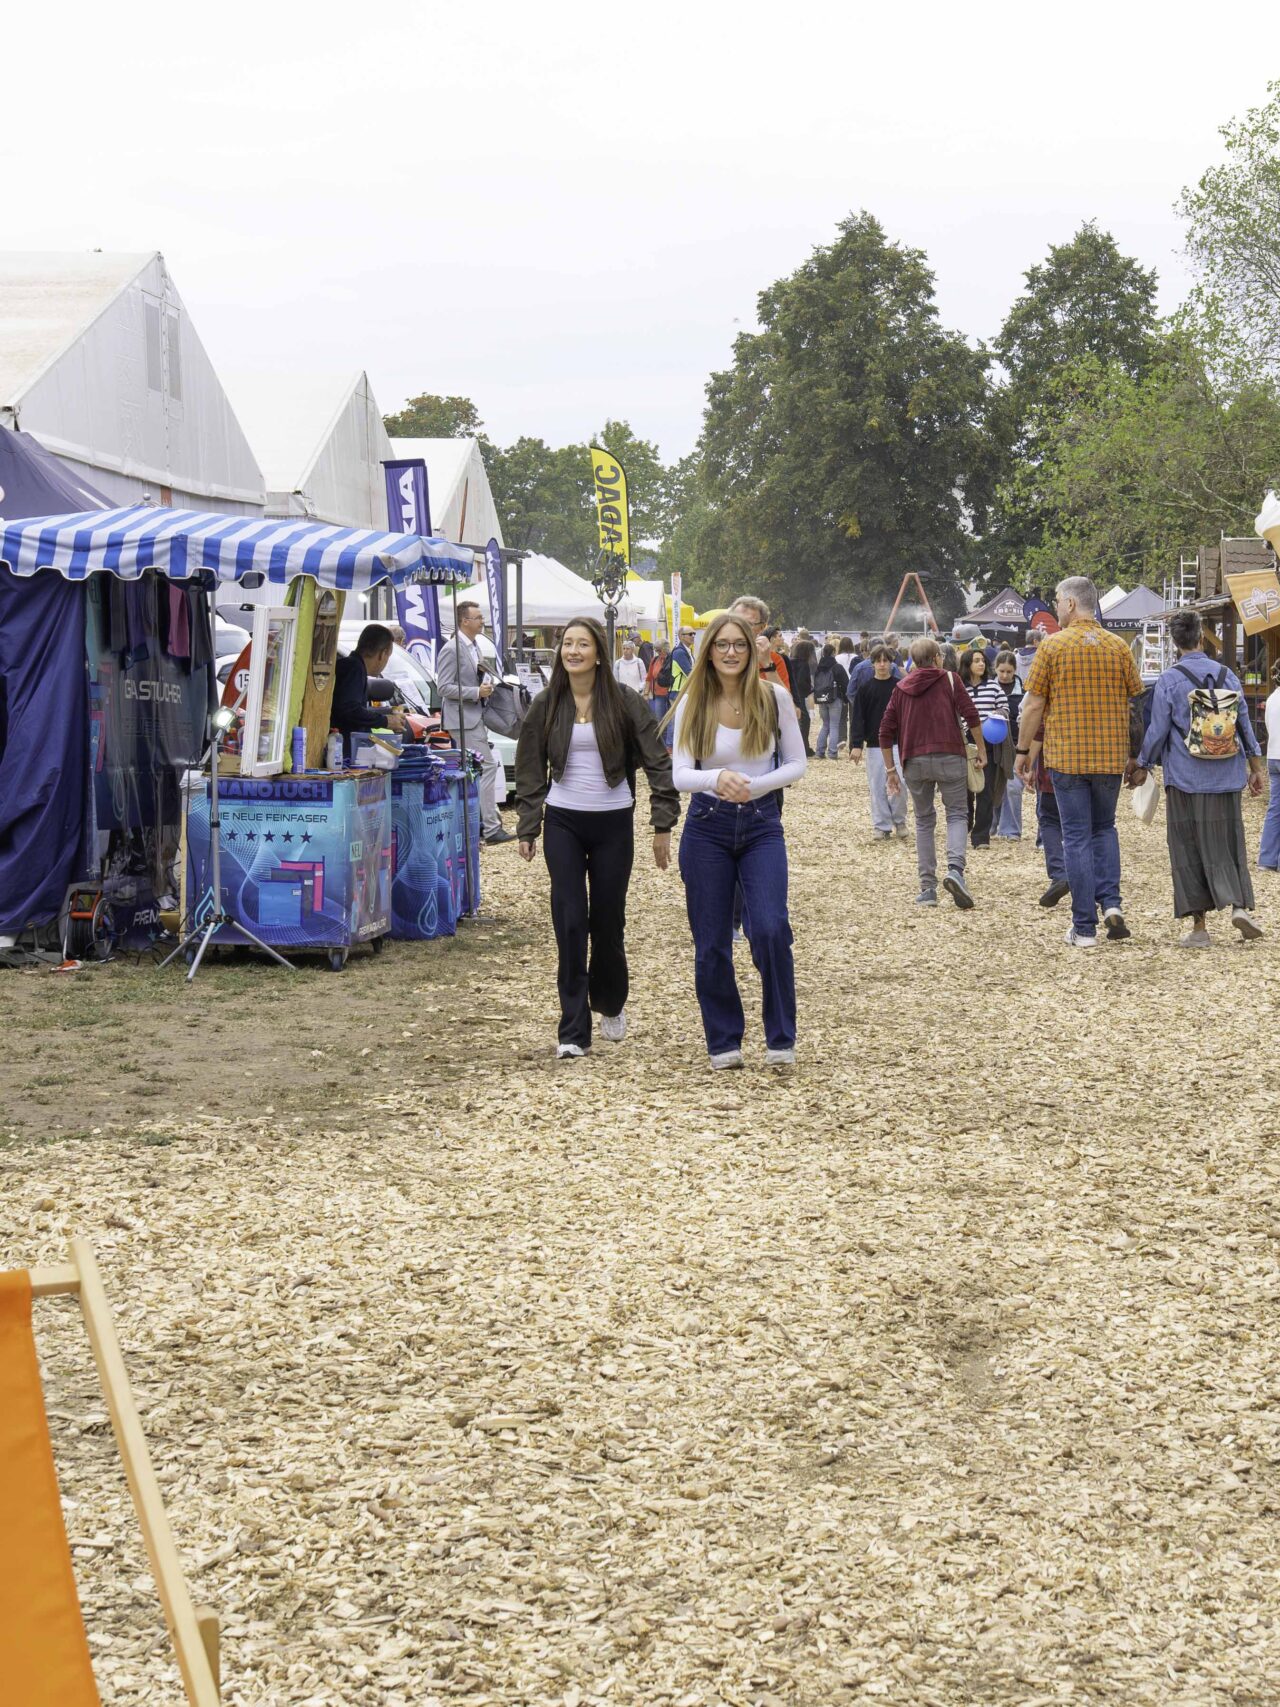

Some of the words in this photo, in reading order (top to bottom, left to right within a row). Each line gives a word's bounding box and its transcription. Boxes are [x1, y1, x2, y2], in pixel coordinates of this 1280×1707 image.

[217, 781, 328, 799] NANOTUCH
[232, 812, 264, 822] NEUE
[265, 813, 328, 824] FEINFASER
